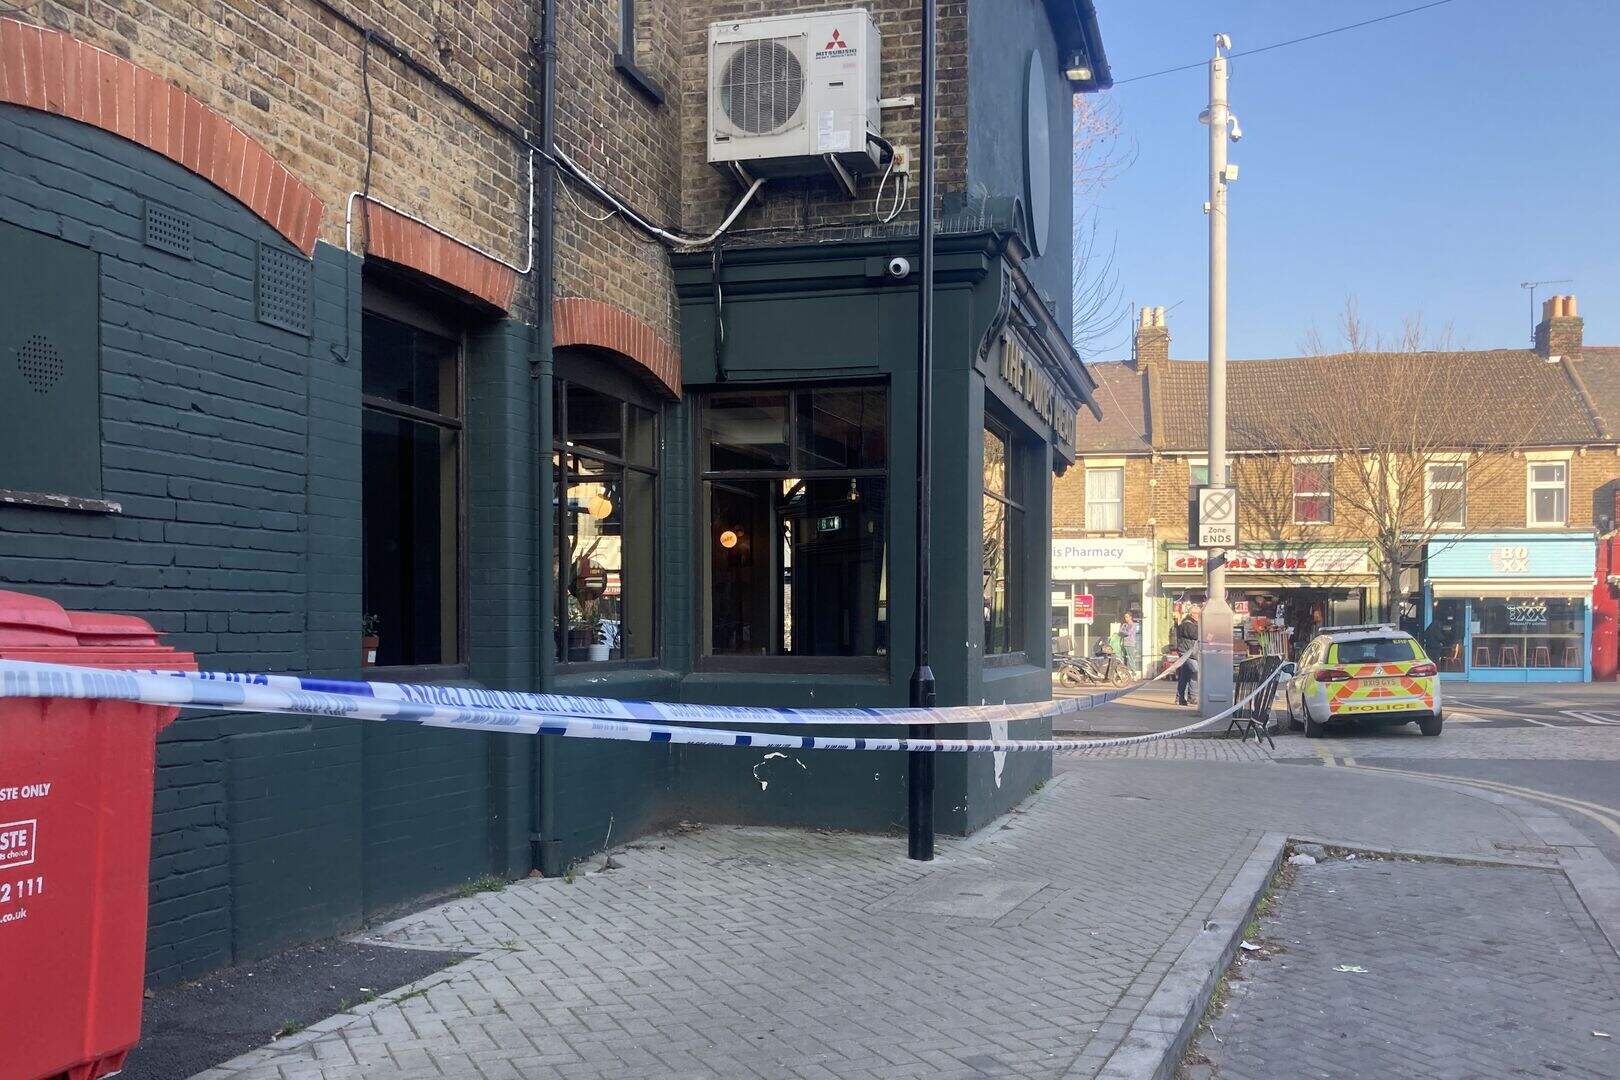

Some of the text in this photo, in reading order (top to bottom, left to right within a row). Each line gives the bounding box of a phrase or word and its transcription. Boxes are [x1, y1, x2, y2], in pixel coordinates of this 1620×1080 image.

[1001, 332, 1024, 394] THE
[1208, 526, 1227, 534] Zone
[1202, 535, 1232, 543] ENDS
[1065, 546, 1125, 559] Pharmacy
[1255, 558, 1307, 569] STORE
[1348, 703, 1417, 712] POLICE
[21, 783, 51, 798] ONLY
[0, 829, 27, 850] STE
[17, 876, 43, 898] 111
